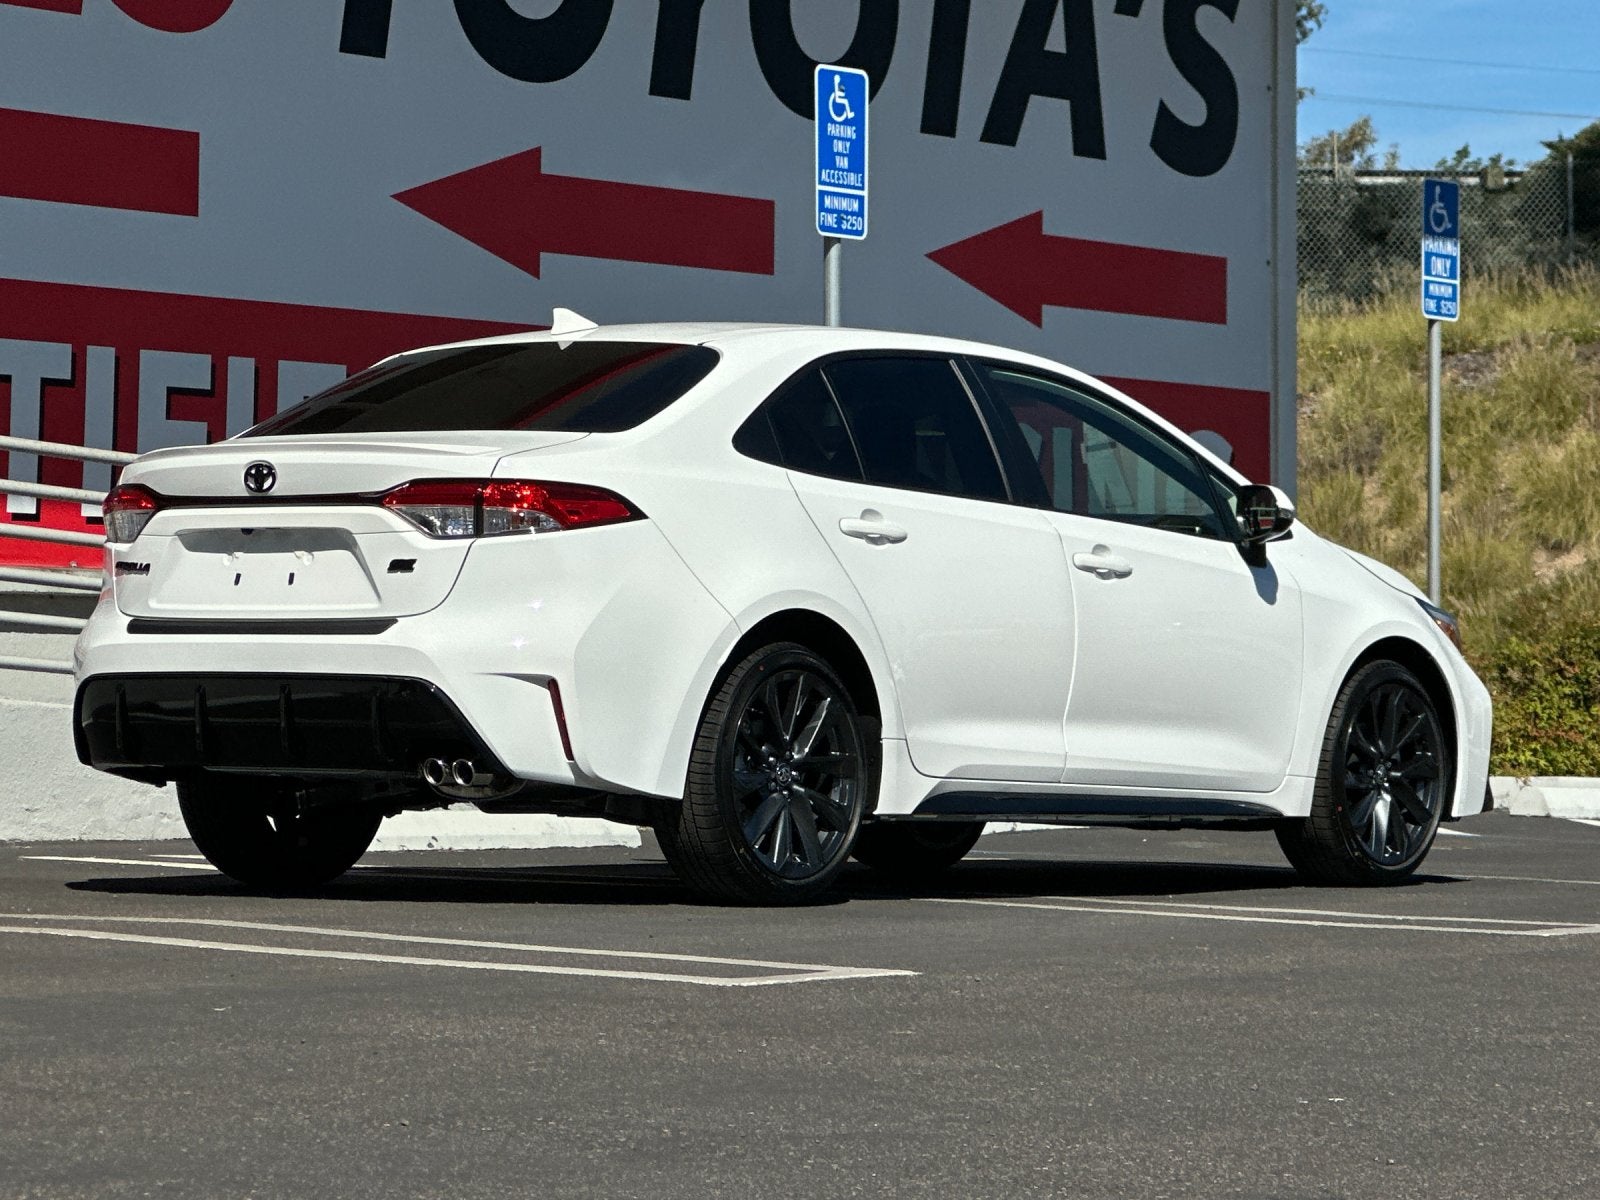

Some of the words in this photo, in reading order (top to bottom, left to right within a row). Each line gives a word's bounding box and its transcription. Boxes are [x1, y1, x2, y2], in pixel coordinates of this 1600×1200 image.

[340, 0, 1240, 177] OTA'S
[827, 123, 856, 139] PARKING
[833, 139, 850, 155] ONLY
[835, 156, 848, 169] VAN
[821, 169, 863, 187] ACCESSIBLE
[824, 195, 859, 212] MINIMUM
[820, 212, 838, 228] FINE
[840, 214, 863, 231] $250
[1424, 235, 1457, 256] PARKING
[1431, 256, 1451, 276] ONLY
[0, 338, 347, 516] TIF
